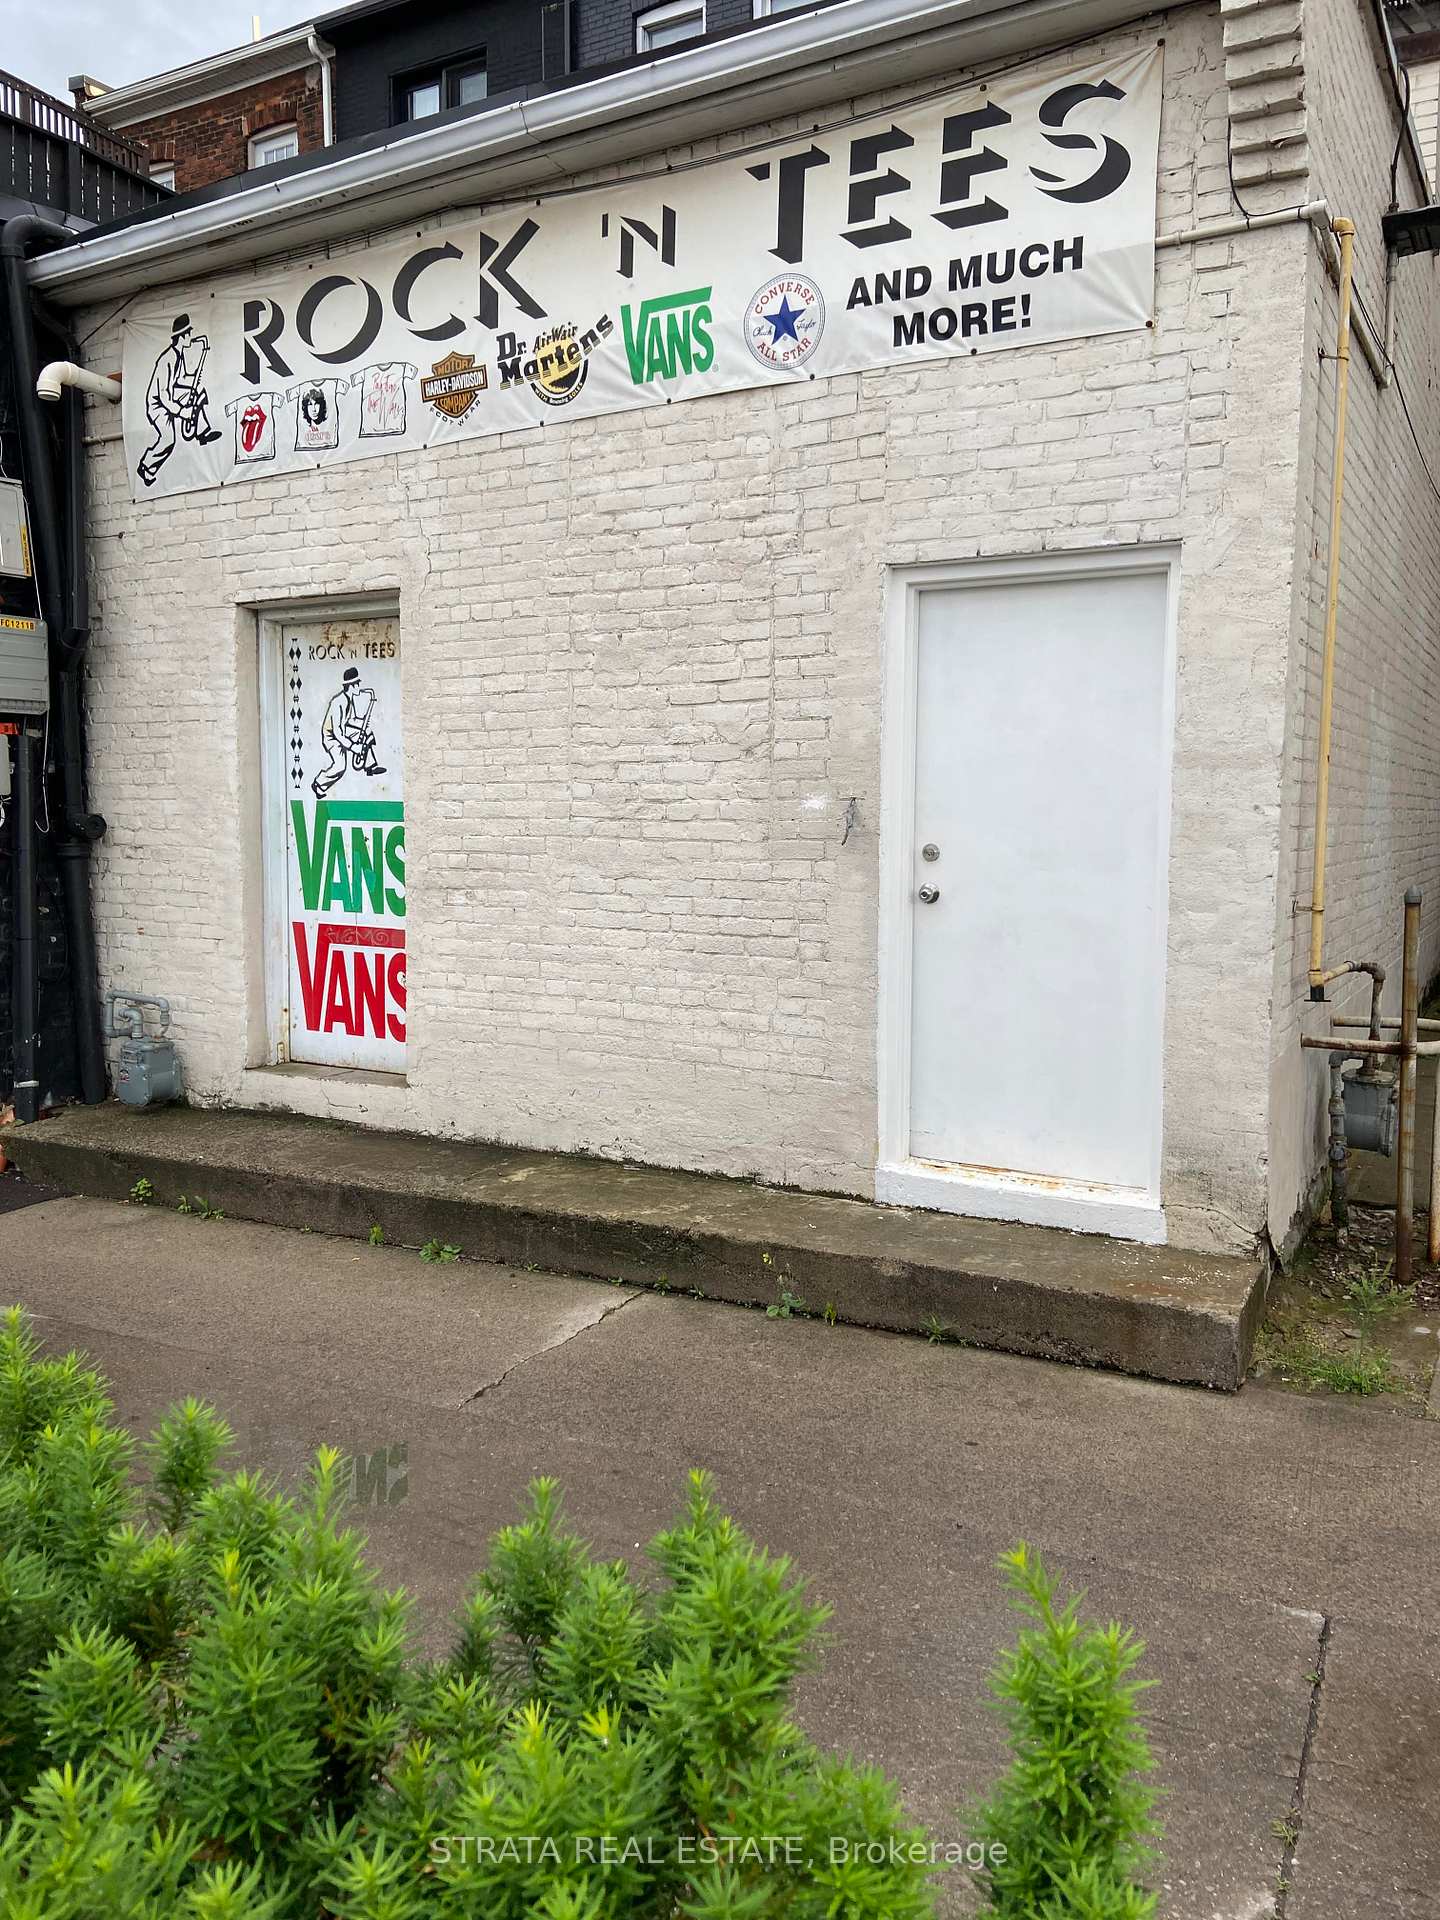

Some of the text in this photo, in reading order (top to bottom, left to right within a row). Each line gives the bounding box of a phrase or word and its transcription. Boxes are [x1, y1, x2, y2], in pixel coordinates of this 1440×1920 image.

[240, 79, 1131, 384] ROCK 'N TEES
[846, 236, 1084, 310] AND MUCH
[755, 281, 815, 314] CONVERSE
[620, 286, 715, 386] VANS
[892, 294, 1032, 348] MORE!
[496, 331, 527, 362] Dr.
[497, 313, 614, 390] Martens
[532, 322, 579, 354] AirWair
[757, 337, 812, 362] ALL STAR
[437, 359, 470, 375] MOTOR
[425, 371, 484, 397] HARLEY-DAVIDSON
[440, 391, 472, 413] COMPANY
[308, 642, 346, 661] ROCK
[363, 641, 396, 660] TEES
[290, 800, 406, 917] VANS
[292, 922, 407, 1043] VANS
